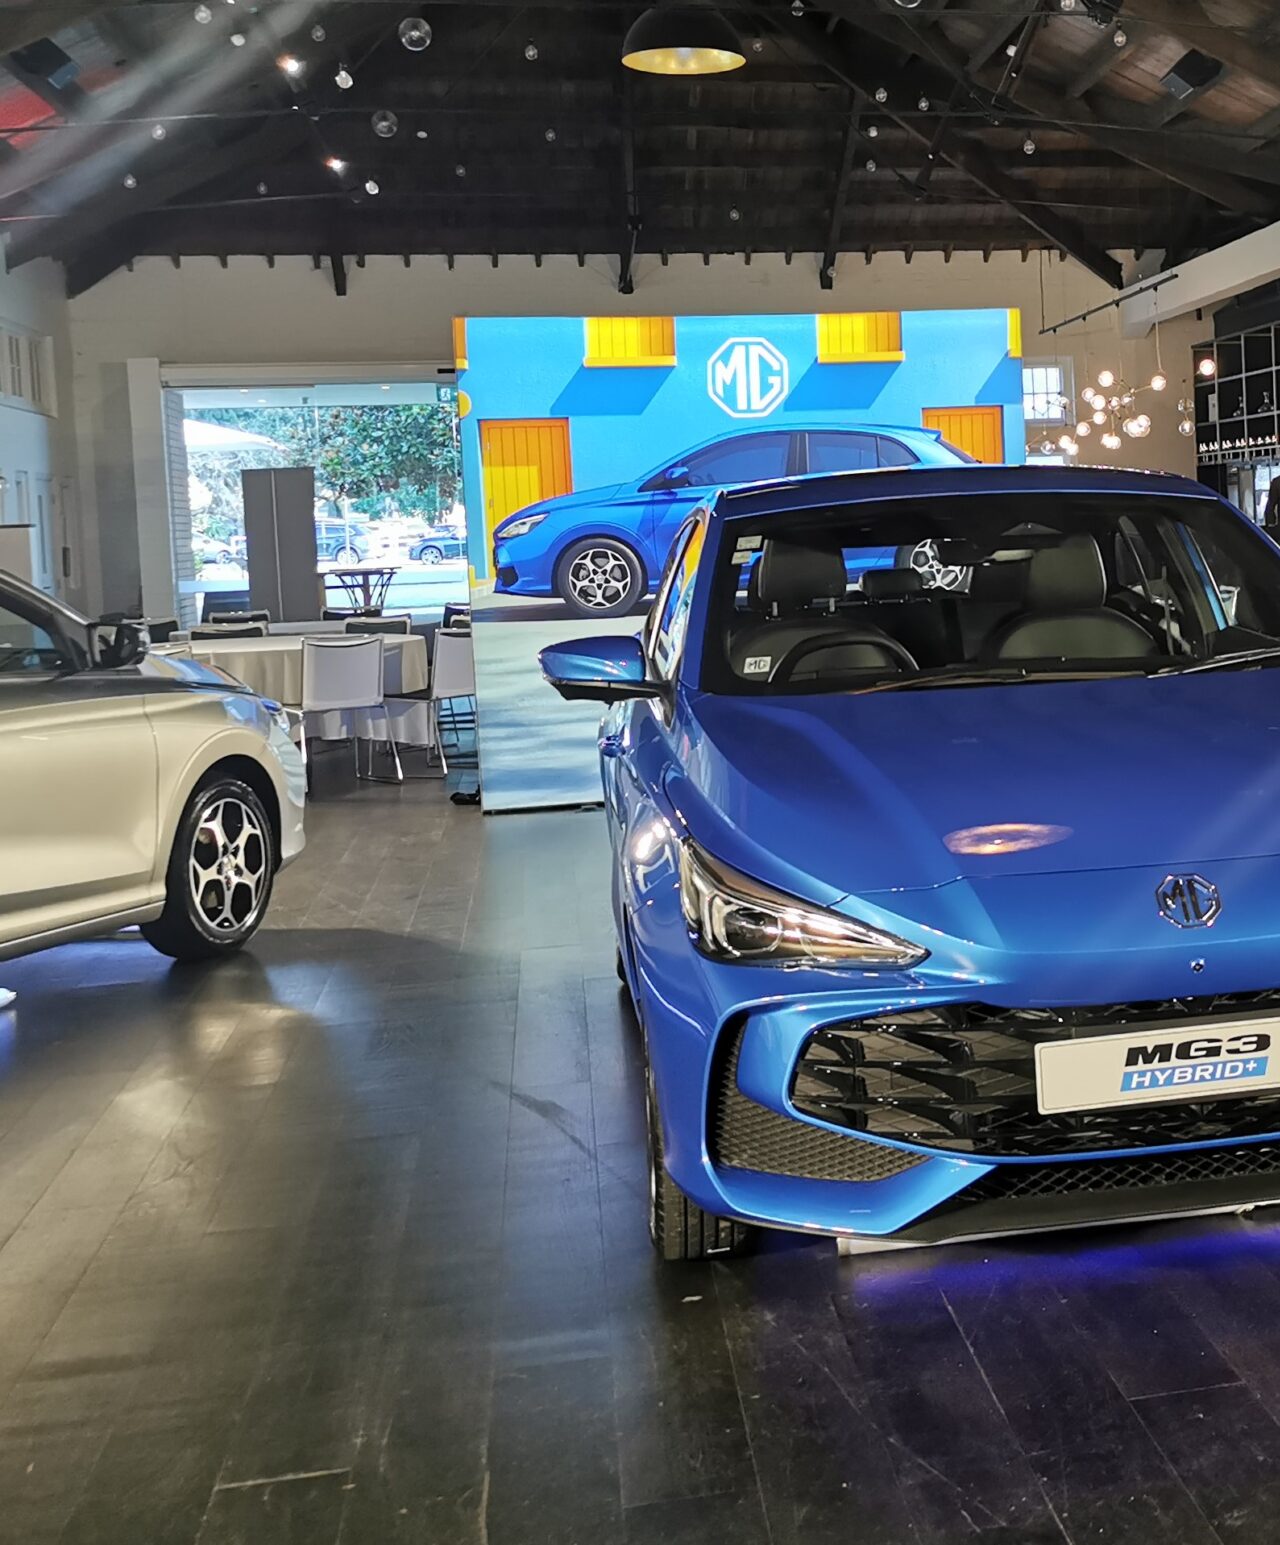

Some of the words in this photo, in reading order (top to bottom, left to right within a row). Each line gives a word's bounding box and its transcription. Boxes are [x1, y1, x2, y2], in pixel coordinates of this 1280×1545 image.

[714, 342, 783, 412] MG
[747, 659, 769, 671] MG
[1160, 876, 1219, 925] MG
[1124, 1033, 1271, 1067] MG3
[1130, 1060, 1258, 1089] HYBRID+
